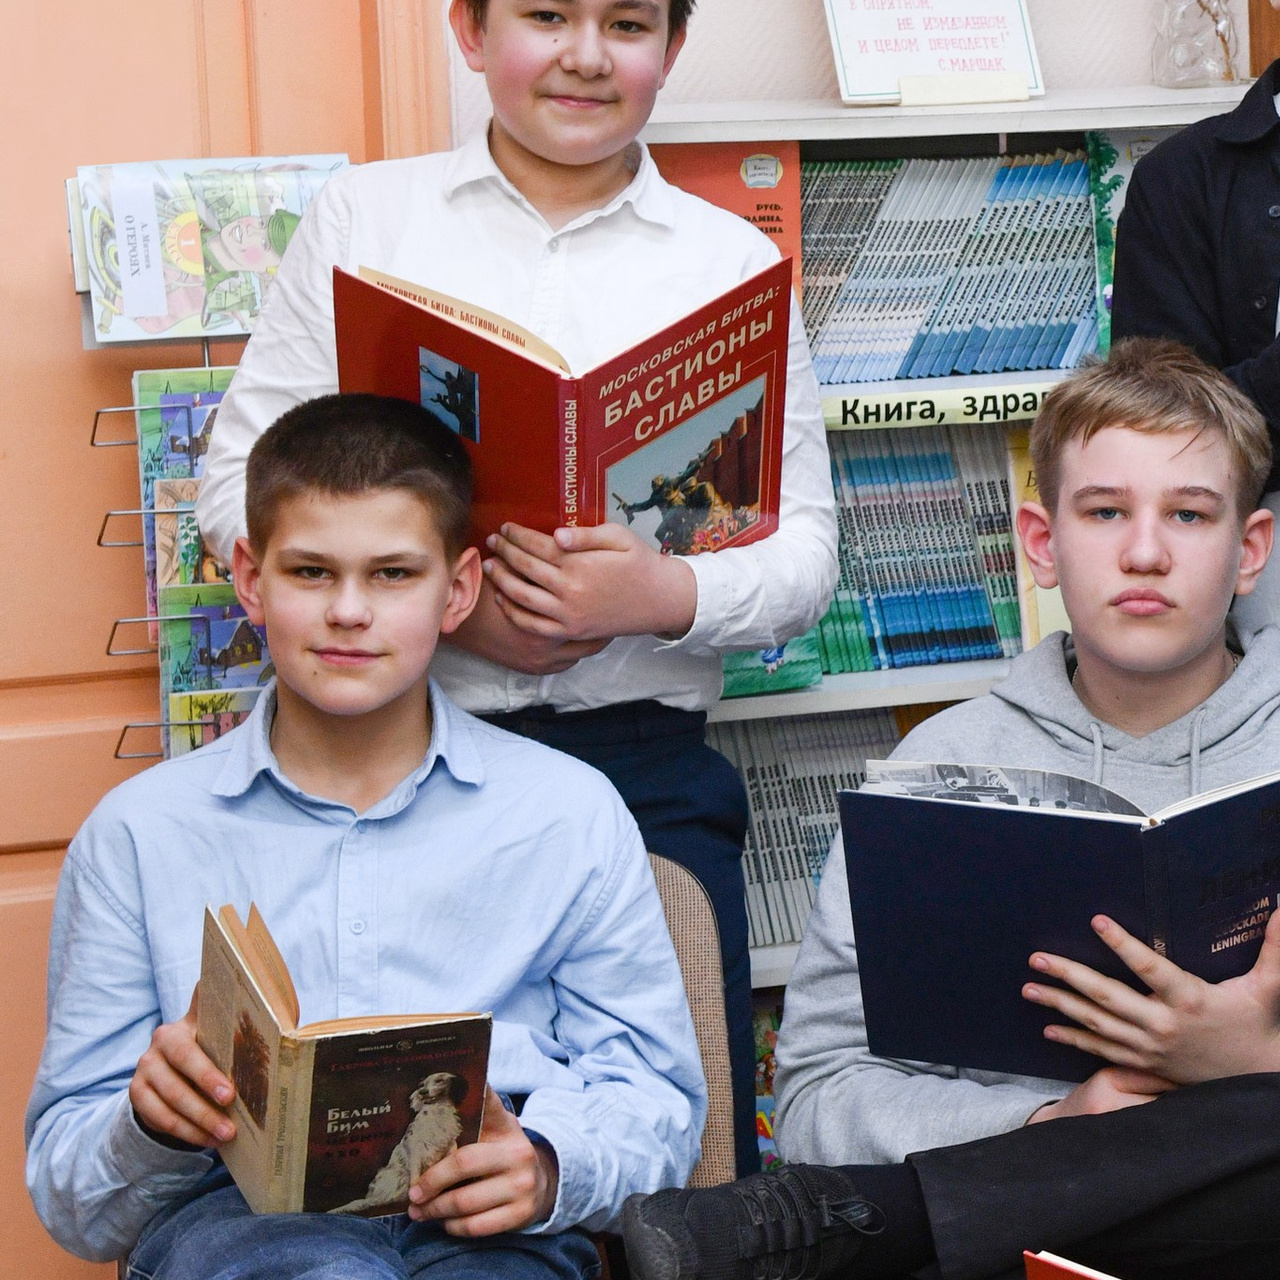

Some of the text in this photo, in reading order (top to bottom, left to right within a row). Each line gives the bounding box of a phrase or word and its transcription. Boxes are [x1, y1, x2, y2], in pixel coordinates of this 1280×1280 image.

[897, 17, 1007, 30] НЕ ИЗМАЗАННОМ
[858, 39, 869, 53] И
[874, 38, 920, 53] ЦЕЛОМ
[125, 215, 141, 278] О ГЕРОЯХ
[180, 238, 196, 246] 1
[459, 310, 499, 336] БАСТИОНЫ
[501, 326, 527, 347] СЛАВЫ
[599, 285, 781, 399] МОСКОВСКАЯ БИТВА:
[604, 309, 774, 428] БАСТИОНЫ
[634, 360, 744, 442] СЛАВЫ
[841, 396, 946, 427] Книга,
[565, 399, 577, 513] БАСТИОНЫ СЛАВЫ
[1210, 927, 1265, 954] LENINGRA
